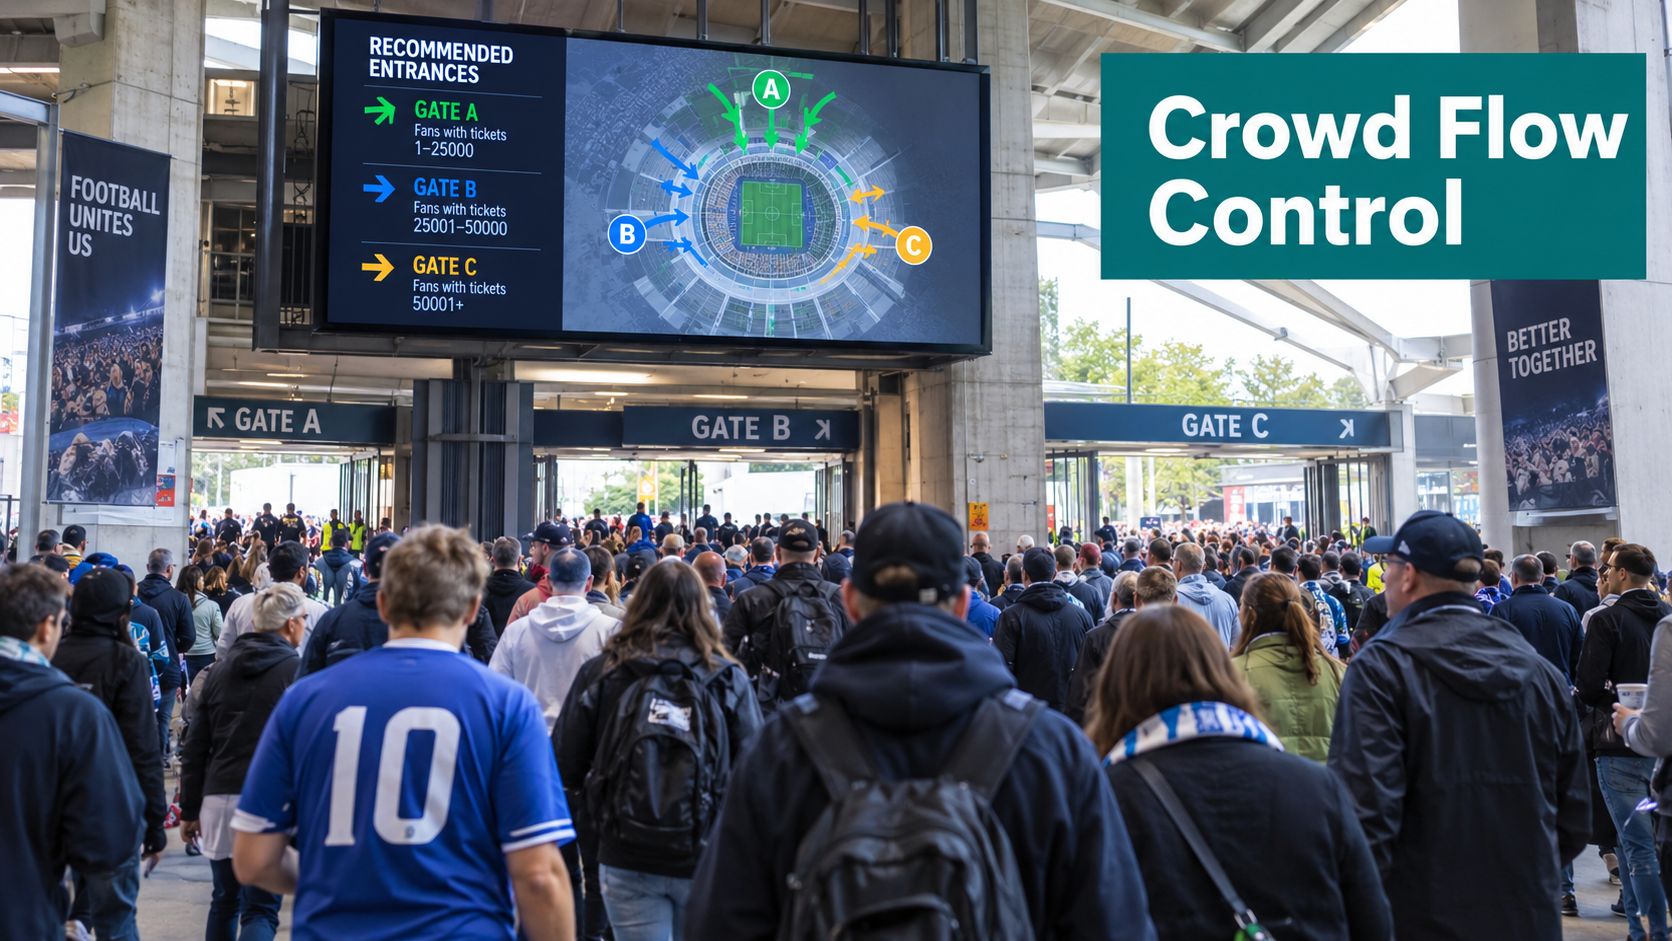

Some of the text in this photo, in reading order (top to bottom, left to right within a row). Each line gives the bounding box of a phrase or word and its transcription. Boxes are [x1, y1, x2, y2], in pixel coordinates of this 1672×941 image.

[369, 36, 514, 65] RECOMMENDED
[369, 58, 480, 84] ENTRANCES
[763, 79, 780, 99] A
[414, 99, 479, 122] GATE A
[414, 123, 507, 141] Fans with tickets
[415, 140, 474, 158] 1–25000
[71, 175, 161, 216] FOOTBALL
[413, 177, 477, 198] GATE B
[69, 202, 134, 237] UNITES
[414, 200, 507, 218] Fans with tickets
[413, 217, 508, 236] 25001–50000
[620, 223, 636, 244] B
[68, 230, 92, 257] US
[905, 235, 922, 255] C
[413, 255, 477, 276] GATE C
[413, 279, 507, 295] Fans with tickets
[412, 295, 464, 312] 50001+
[1507, 317, 1572, 353] BETTER
[1508, 338, 1598, 379] TOGETHER
[235, 406, 322, 434] GATE A
[691, 414, 791, 441] GATE B
[1181, 412, 1269, 439] GATE C
[324, 705, 461, 846] 10
